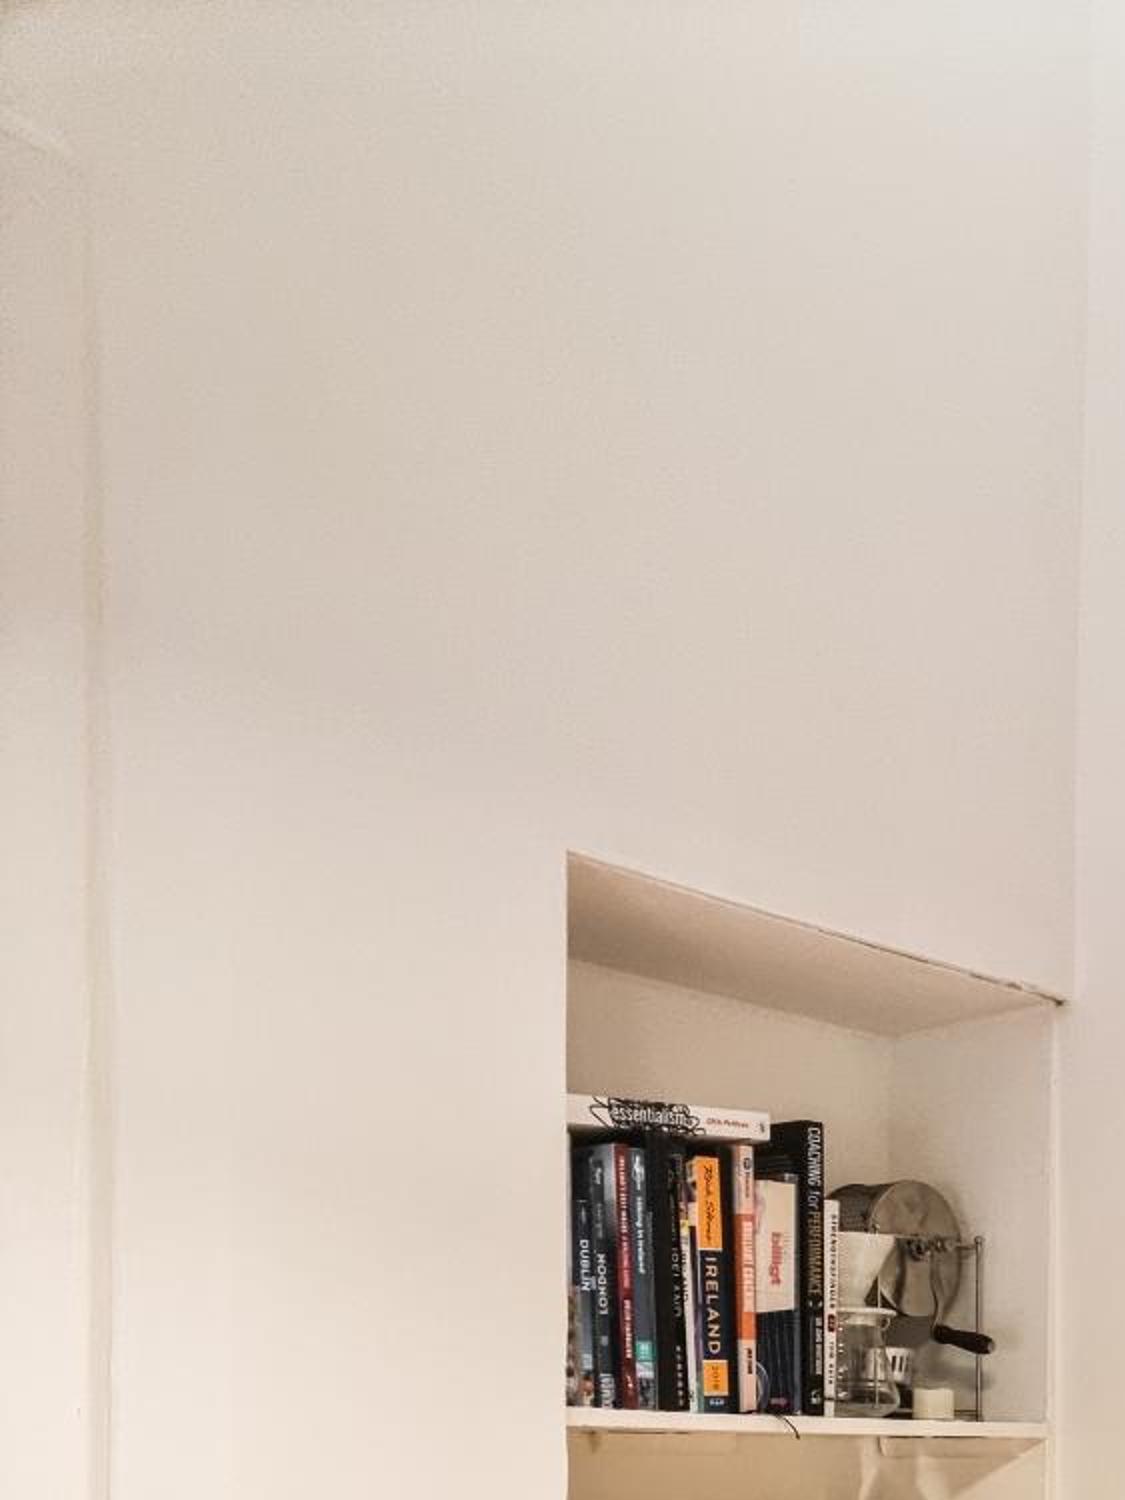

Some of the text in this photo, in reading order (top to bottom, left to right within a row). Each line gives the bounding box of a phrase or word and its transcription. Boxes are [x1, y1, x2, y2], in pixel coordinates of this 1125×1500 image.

[611, 1105, 687, 1126] essentialism
[807, 1127, 822, 1297] COACHING for PERFORMANCE
[579, 1239, 590, 1292] DUBLIN
[596, 1252, 608, 1316] LONDON
[770, 1231, 782, 1286] billigt
[705, 1257, 721, 1354] IRELAND
